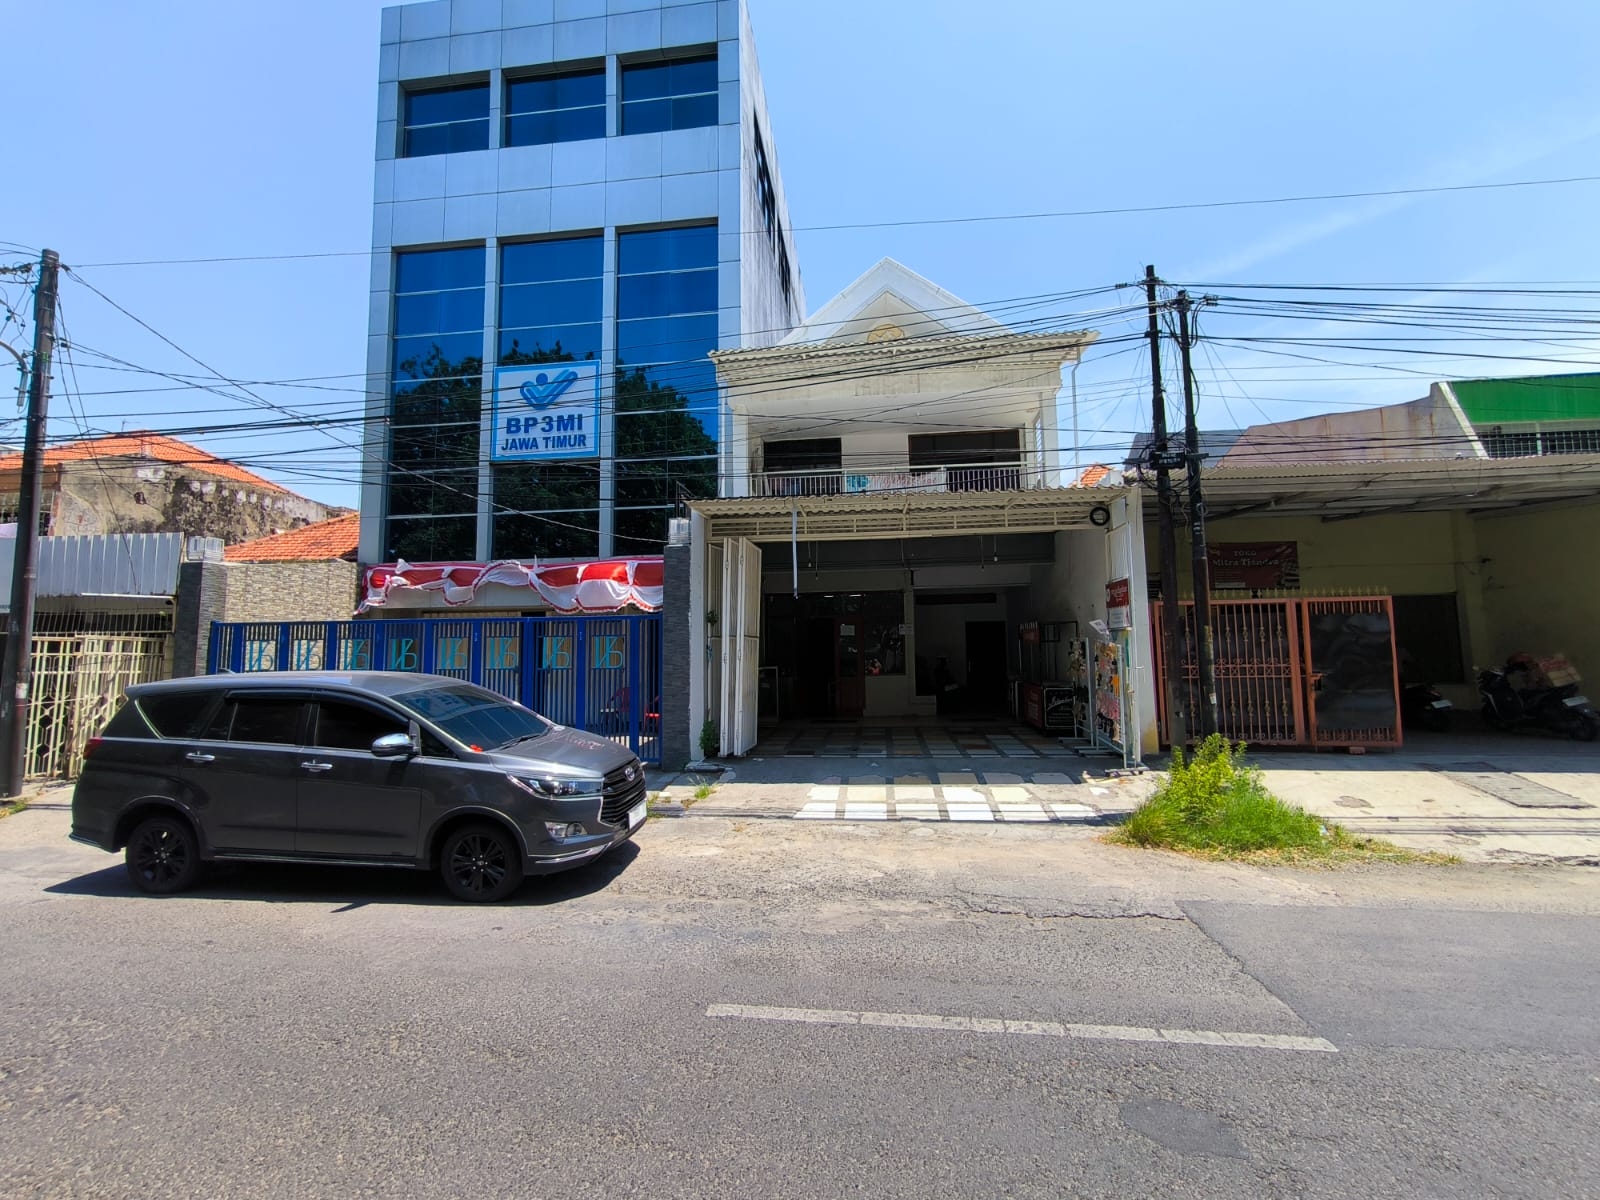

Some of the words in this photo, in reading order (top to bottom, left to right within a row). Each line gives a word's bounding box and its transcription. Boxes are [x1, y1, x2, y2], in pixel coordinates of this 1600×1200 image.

[506, 414, 583, 434] BP3MI
[501, 437, 538, 450] JAWA
[543, 434, 586, 449] TIMUR
